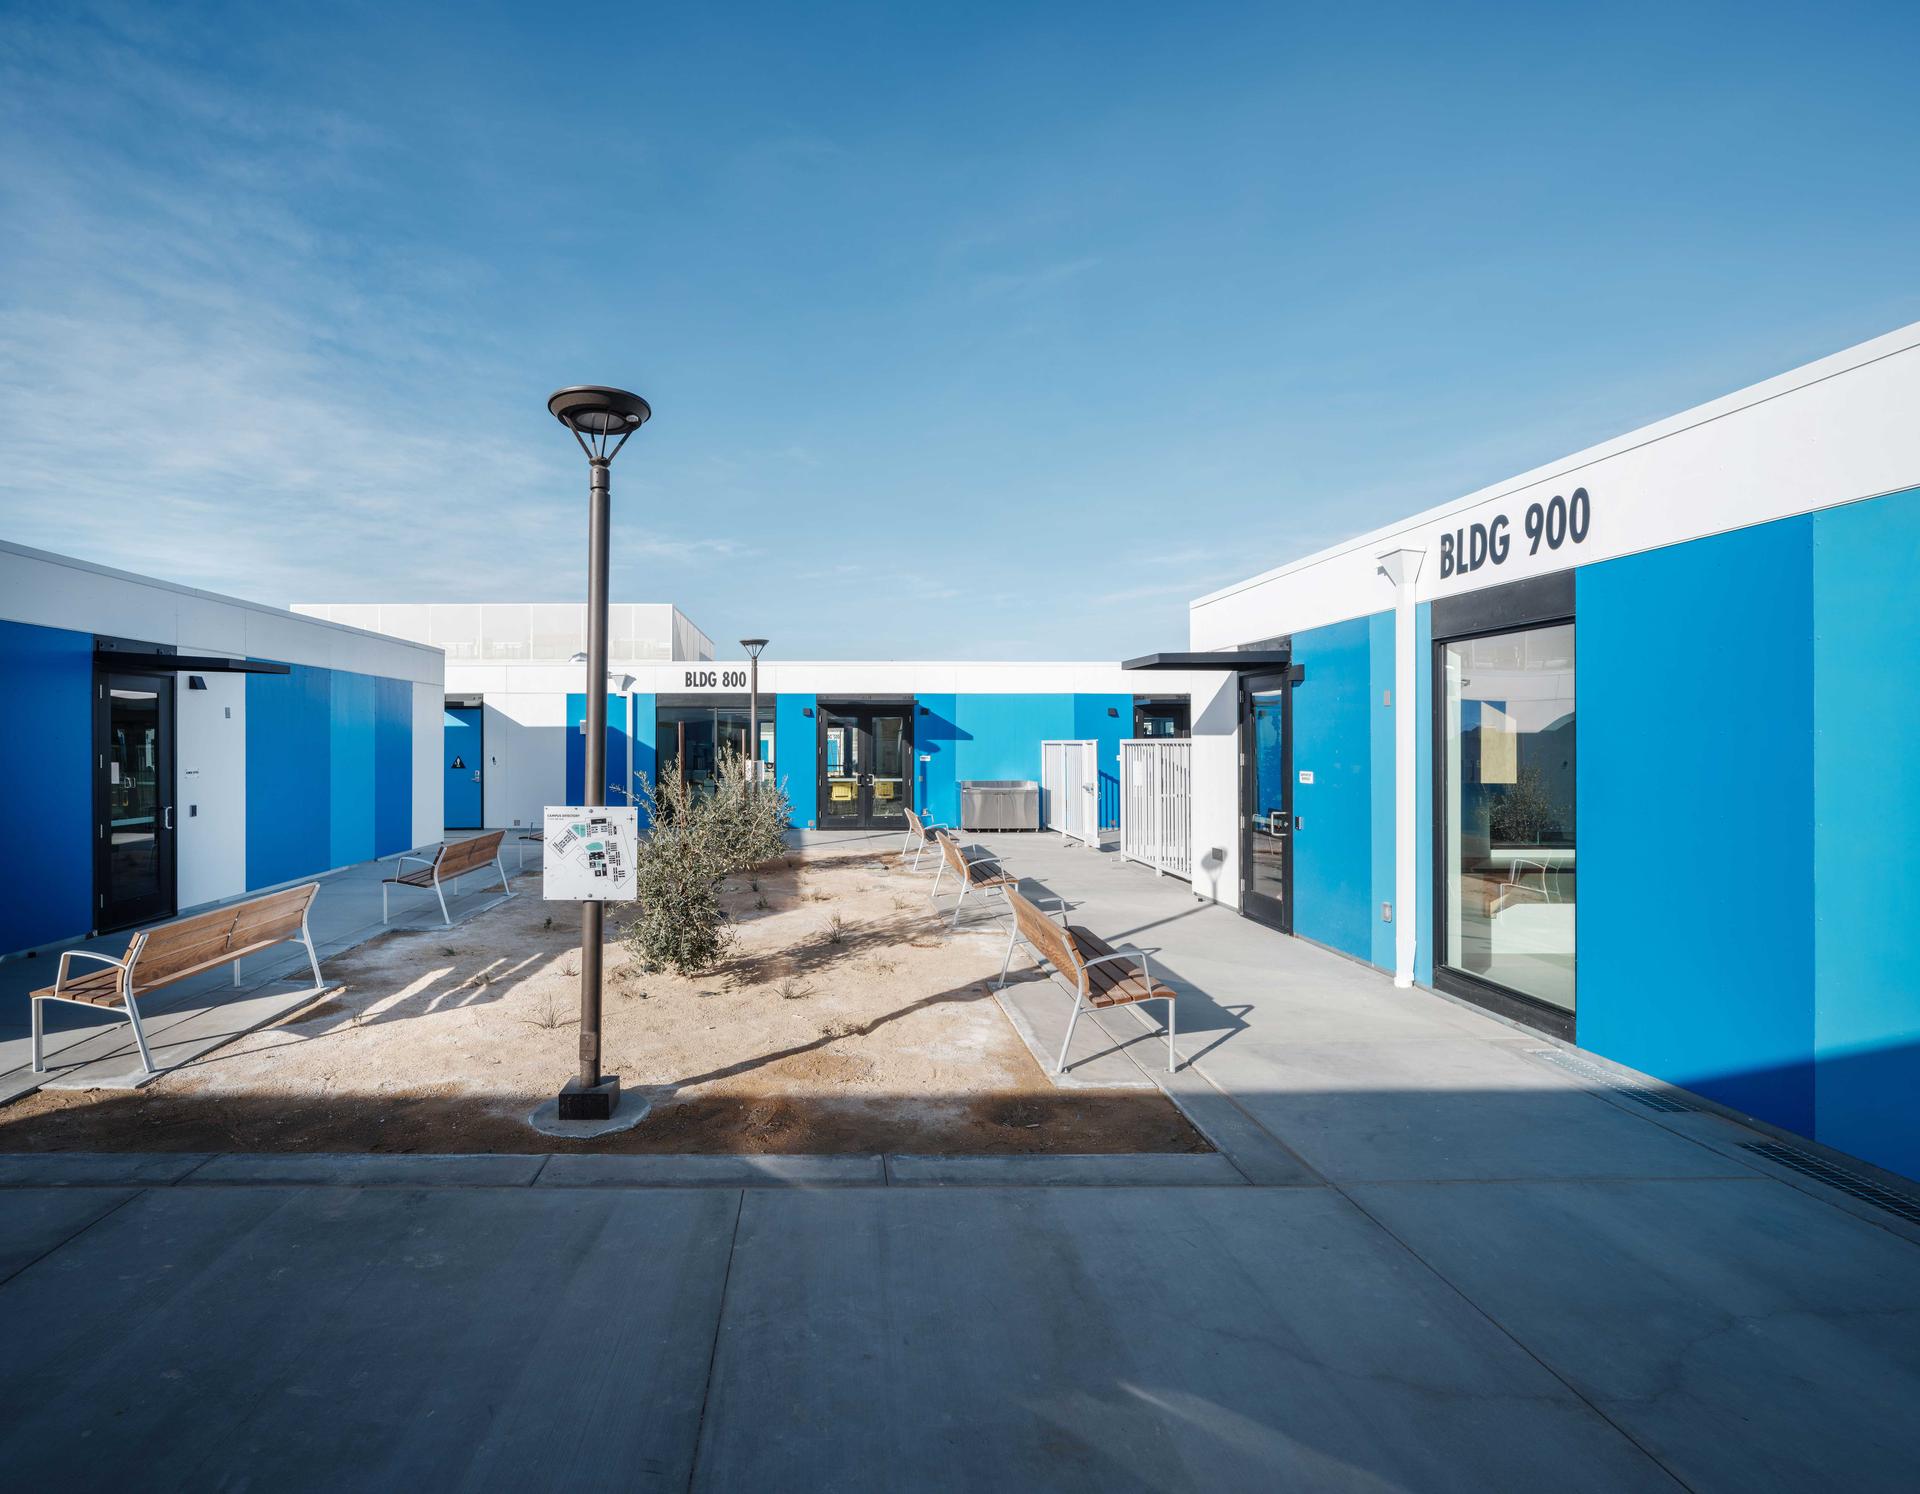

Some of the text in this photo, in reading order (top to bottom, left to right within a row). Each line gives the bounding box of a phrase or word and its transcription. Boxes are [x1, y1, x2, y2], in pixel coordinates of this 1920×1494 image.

[1440, 487, 1590, 579] BLDG 900
[685, 671, 746, 687] BLDG 800
